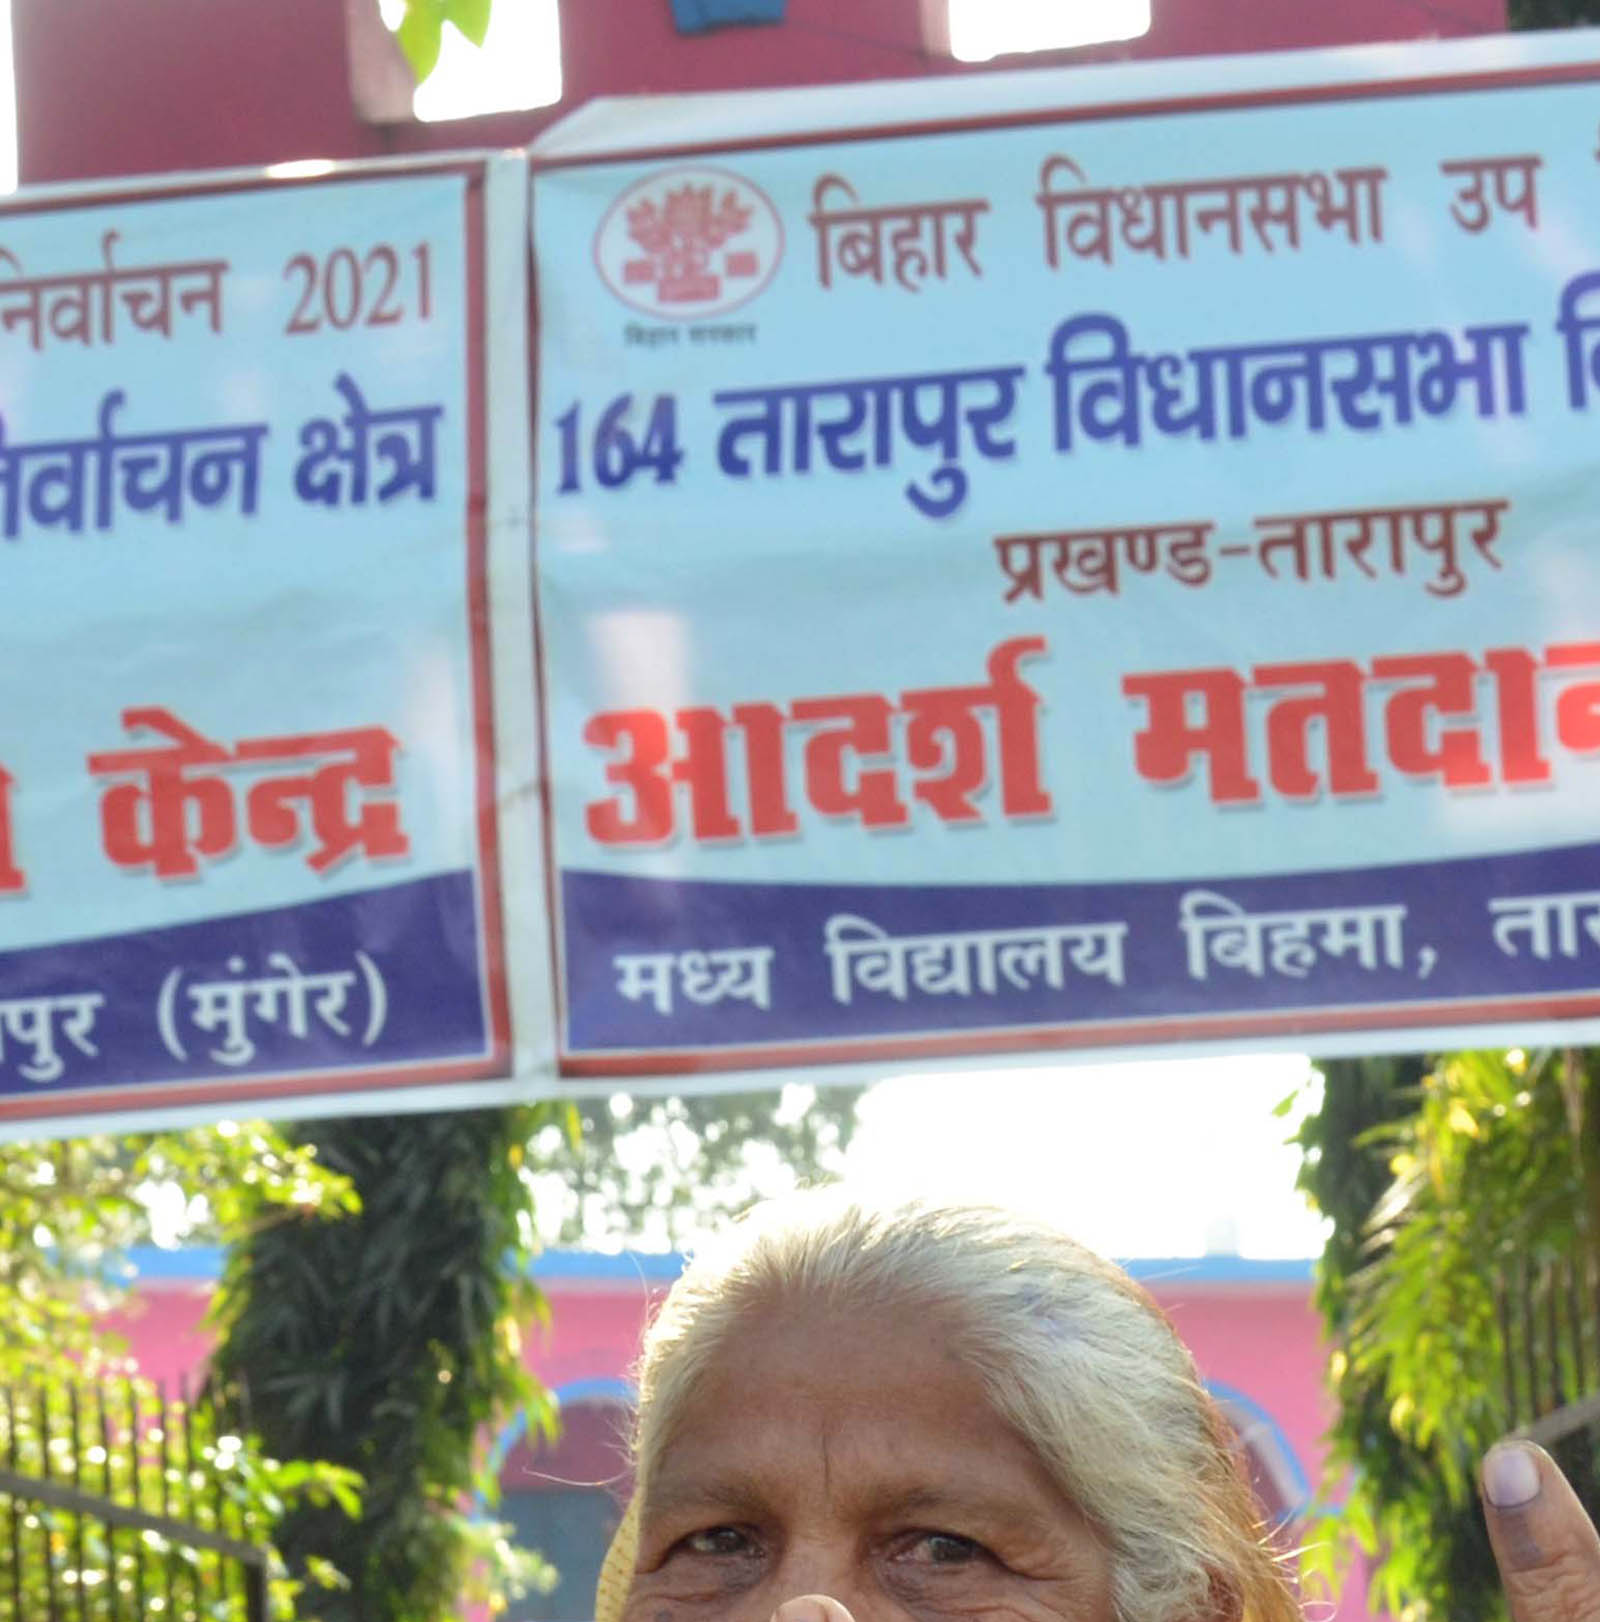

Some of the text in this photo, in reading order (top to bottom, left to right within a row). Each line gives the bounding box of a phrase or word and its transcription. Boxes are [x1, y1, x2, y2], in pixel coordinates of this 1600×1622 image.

[283, 241, 432, 336] 2021
[808, 173, 990, 293] बिहार
[1037, 153, 1388, 270] विधानसभा
[1440, 155, 1543, 235] उप
[293, 372, 443, 509] क्षेत्र
[553, 392, 683, 495] 164
[713, 364, 1026, 519] तारापुर
[1046, 312, 1530, 453] विधानसभा
[87, 706, 409, 877] केन्द्र
[583, 635, 1053, 846] आदर्श
[157, 952, 389, 1067] (मुंगेर)
[614, 946, 774, 1015] मध्य
[824, 913, 1128, 1005] विद्यालय
[1180, 890, 1438, 979] बिहमा,
